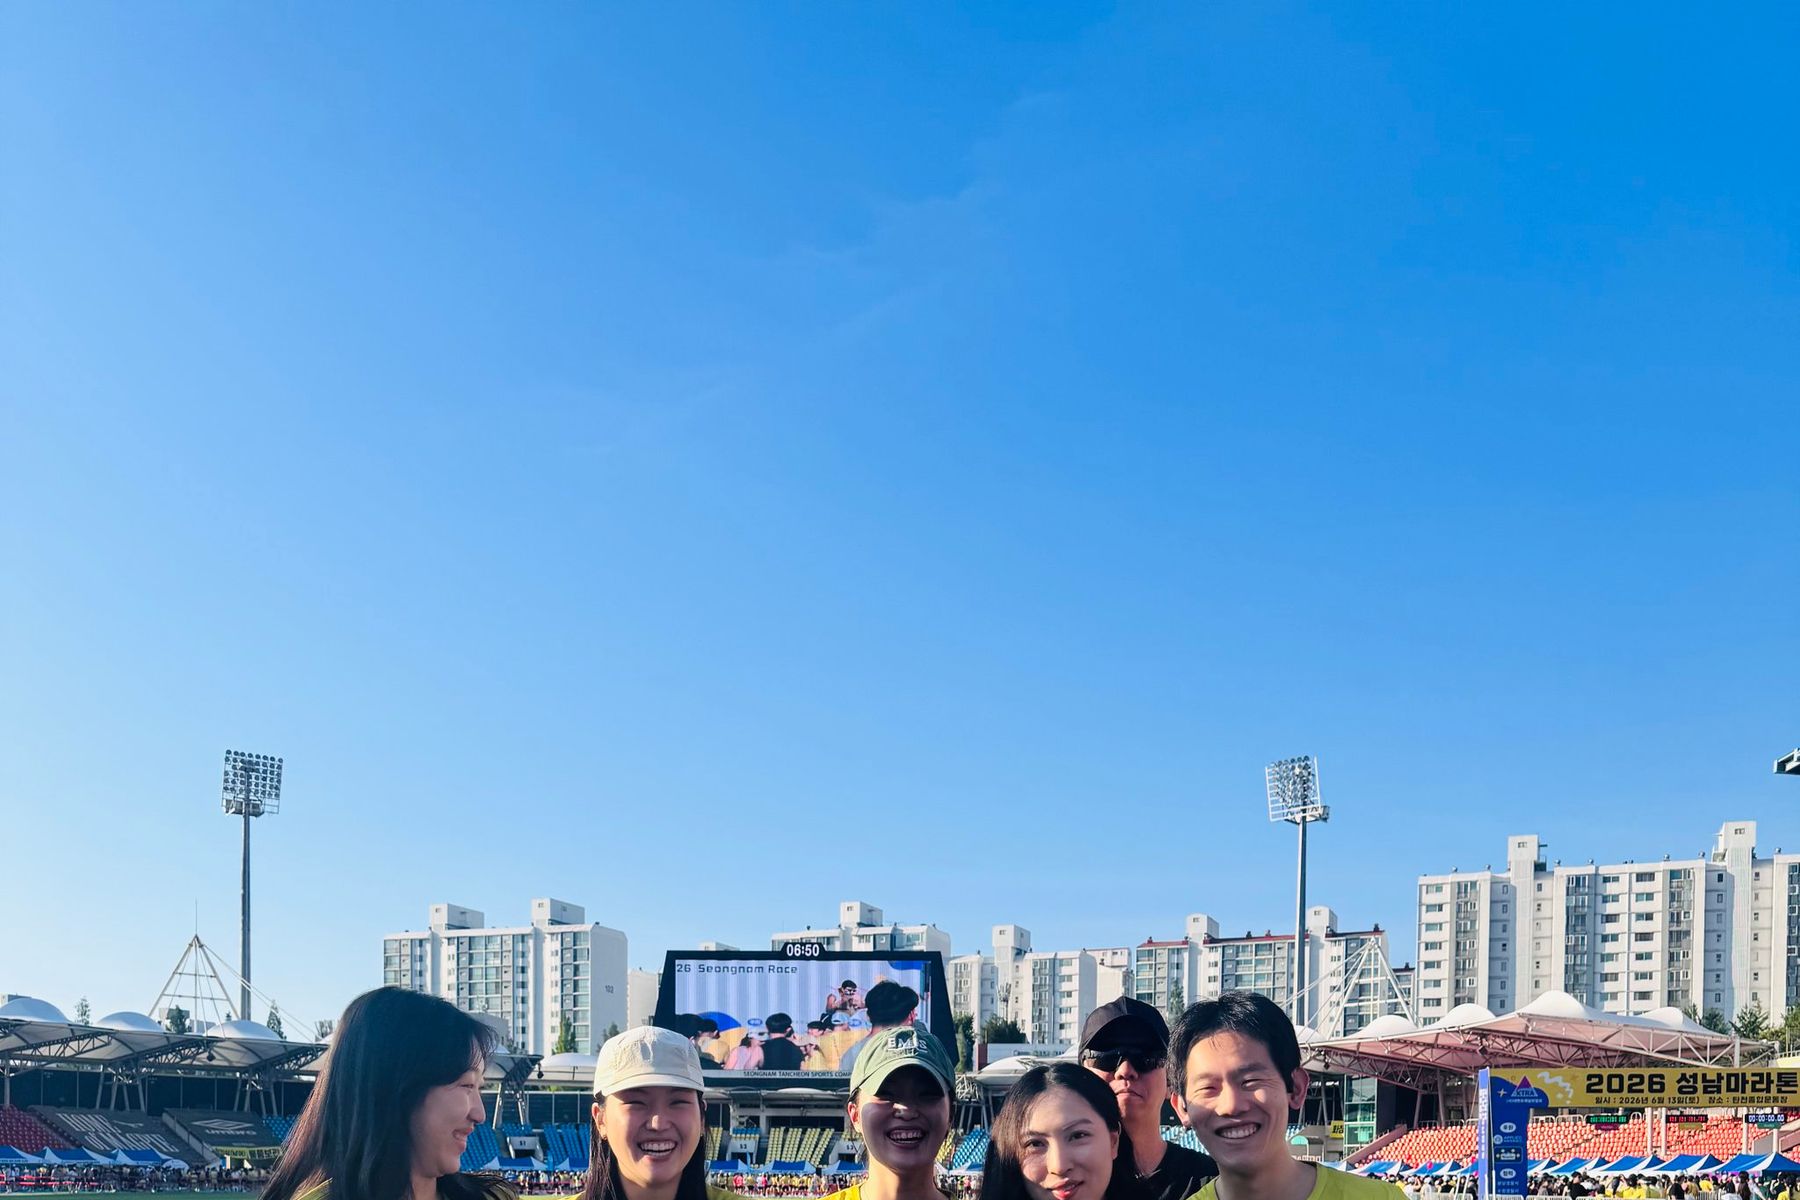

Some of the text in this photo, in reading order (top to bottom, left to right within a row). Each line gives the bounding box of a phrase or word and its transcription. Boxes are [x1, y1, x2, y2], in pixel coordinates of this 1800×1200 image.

[786, 944, 820, 957] 06:50
[676, 963, 798, 976] 26 Seongnam Race
[1585, 1071, 1799, 1095] 2026 성남마라톤
